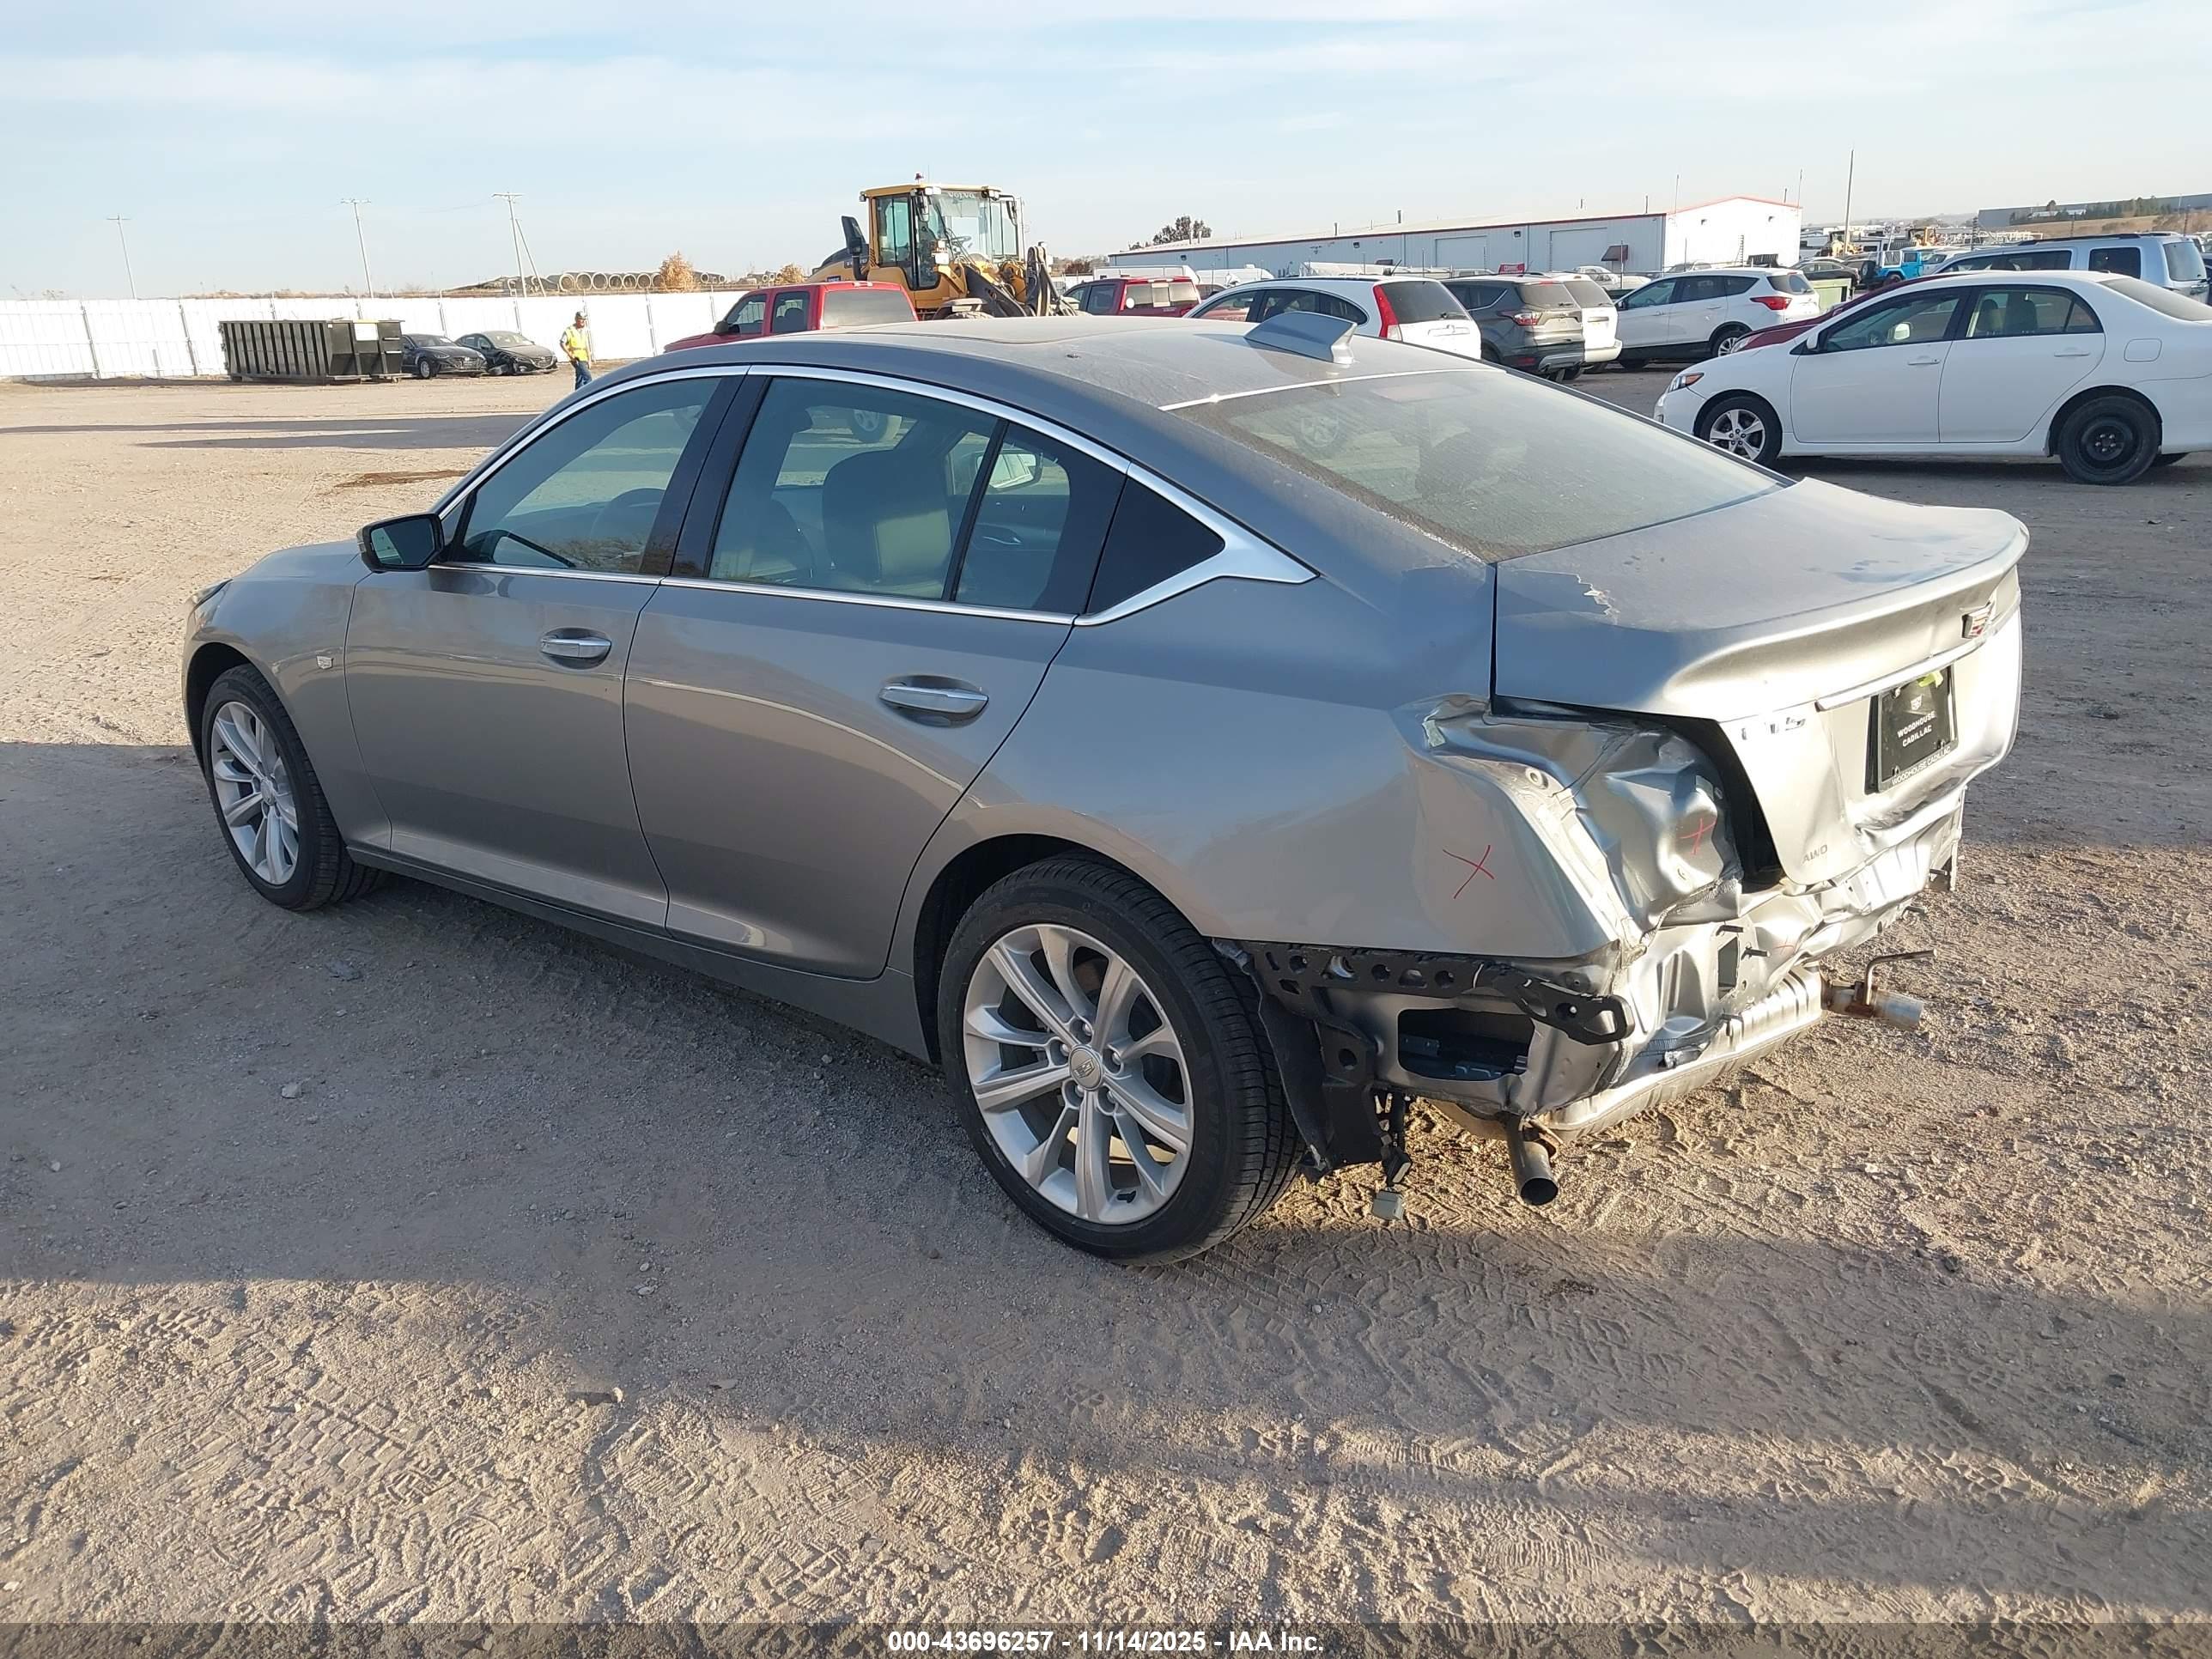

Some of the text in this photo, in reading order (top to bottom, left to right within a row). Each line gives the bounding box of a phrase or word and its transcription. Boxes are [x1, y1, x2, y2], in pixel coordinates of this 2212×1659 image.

[1897, 711, 1936, 737] WOODHOUSE
[1902, 725, 1933, 748] CADILLAC
[1891, 745, 1952, 785] WOODHOUSE CADILLAC
[1802, 844, 1828, 864] AWD
